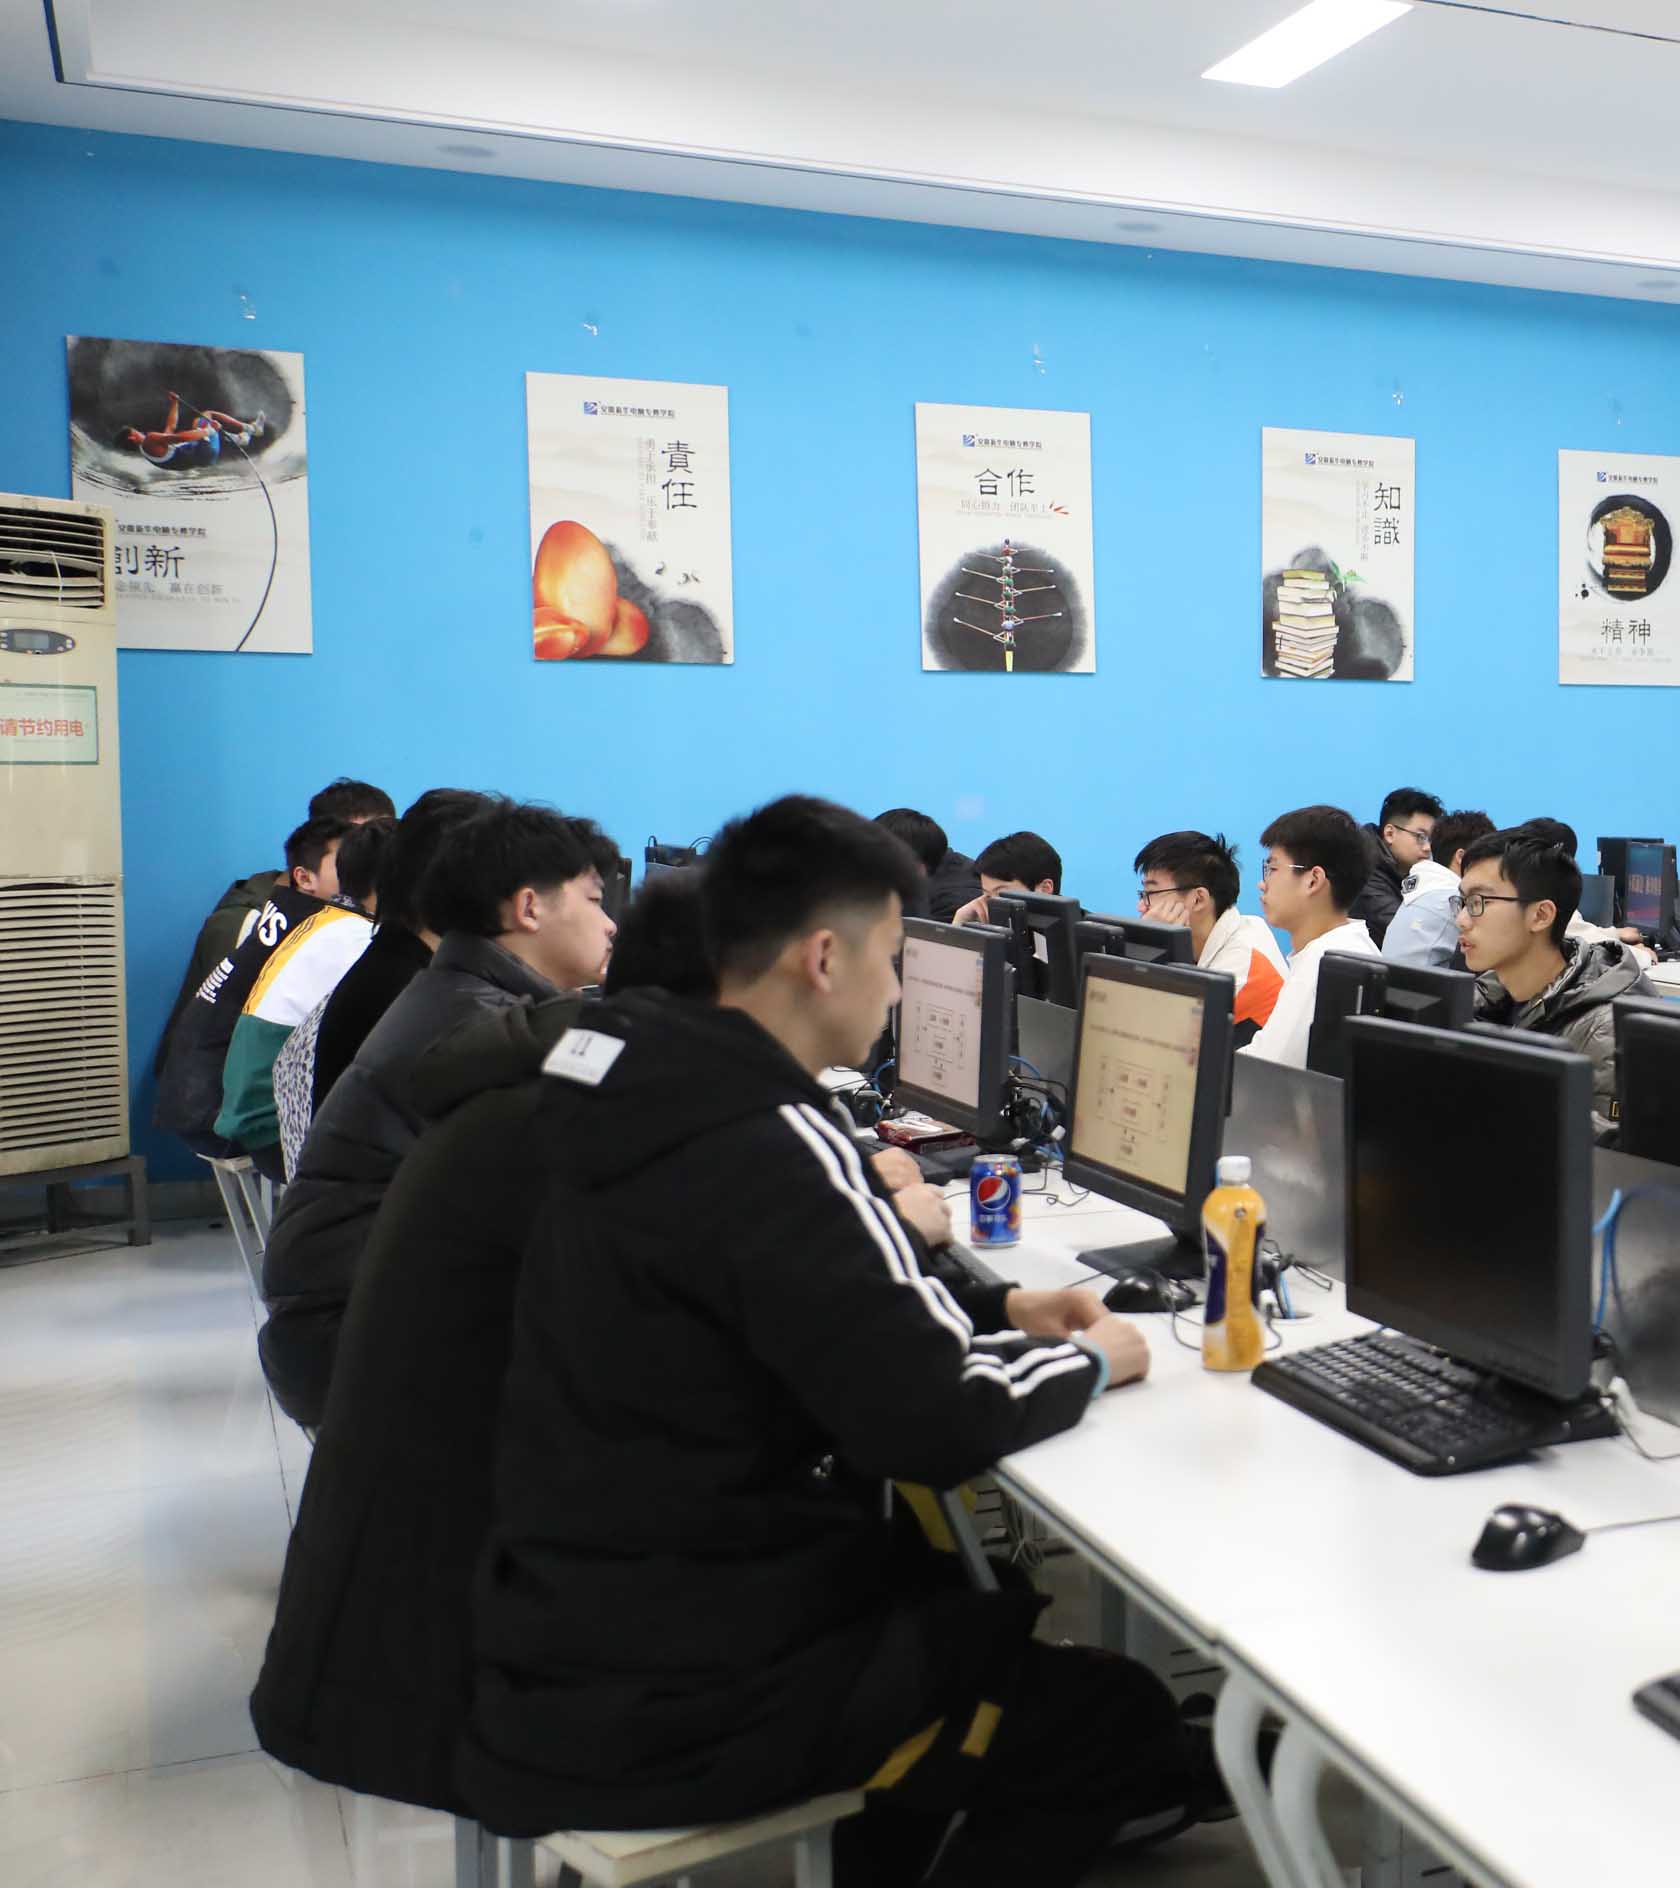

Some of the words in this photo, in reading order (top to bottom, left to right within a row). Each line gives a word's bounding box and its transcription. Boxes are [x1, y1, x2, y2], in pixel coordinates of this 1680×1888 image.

[661, 440, 698, 511] 責任
[974, 468, 1035, 497] 合作
[1373, 482, 1401, 545] 知識
[1601, 618, 1651, 645] 精神
[0, 718, 84, 737] 请节约用电
